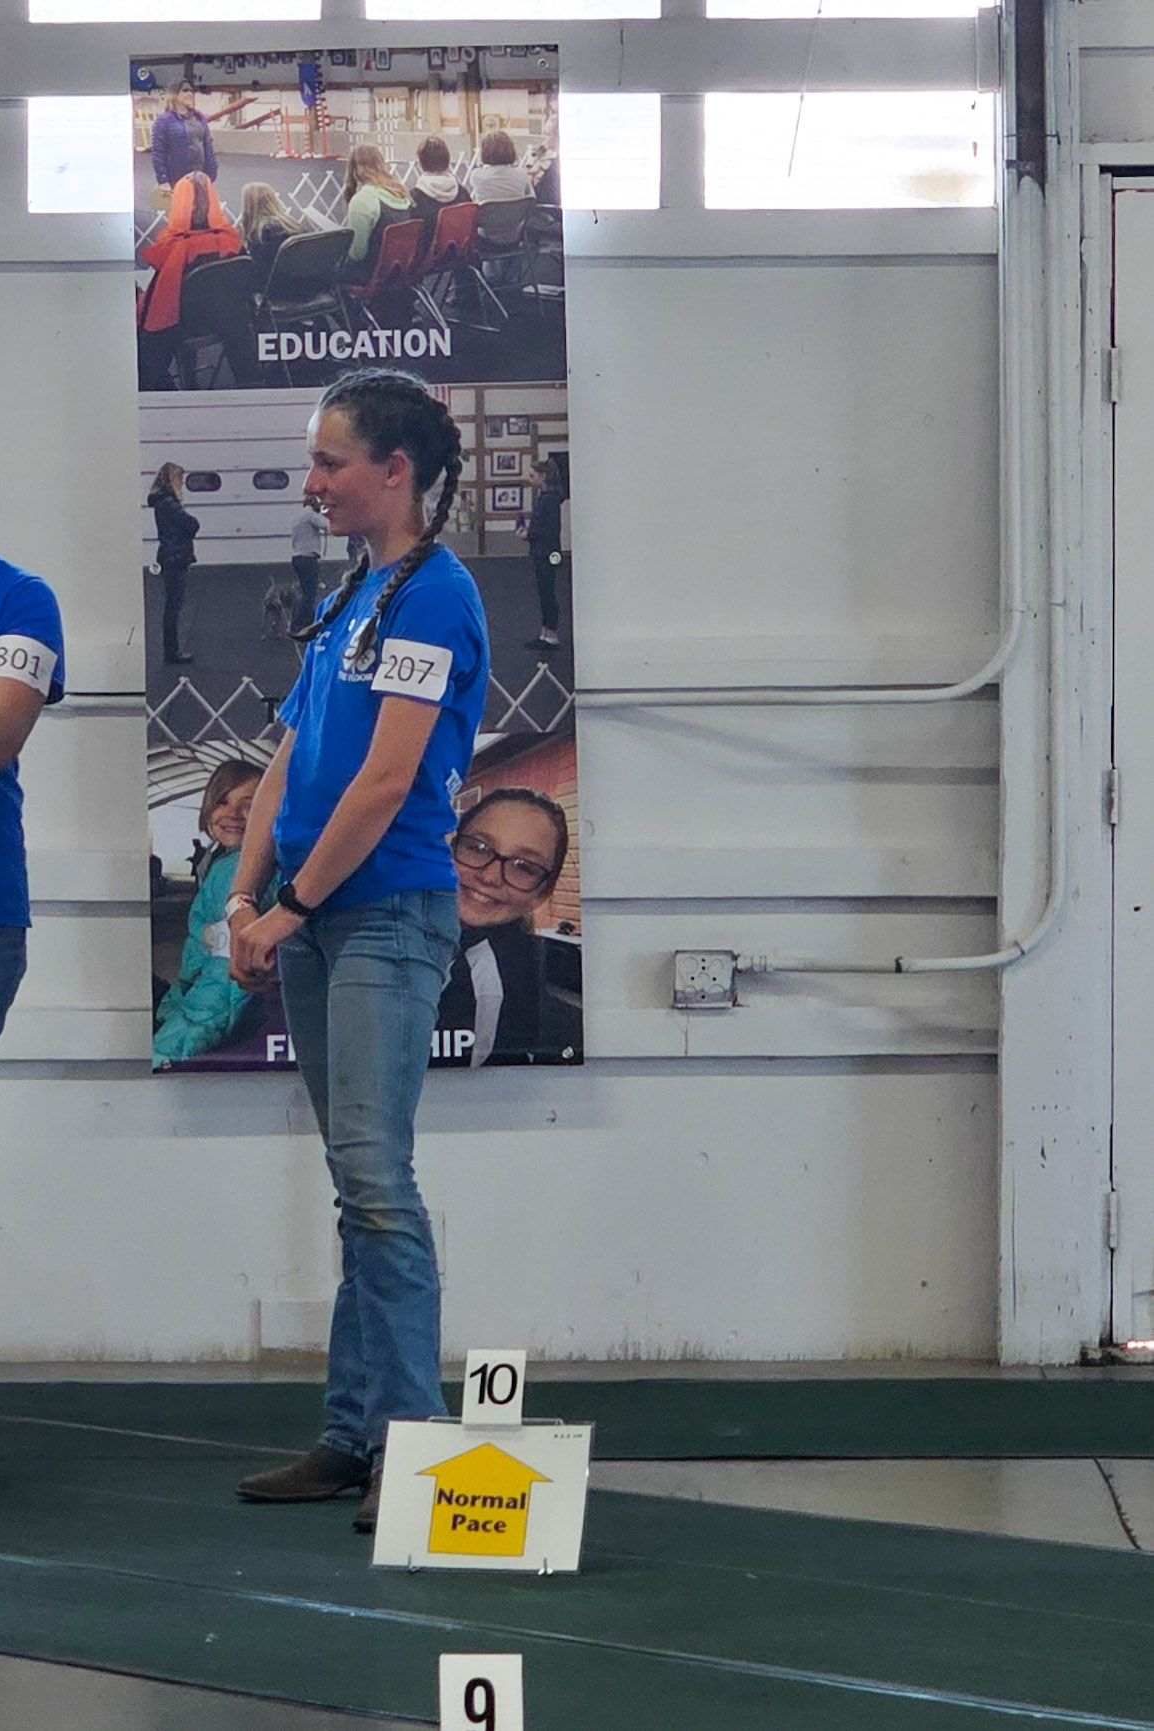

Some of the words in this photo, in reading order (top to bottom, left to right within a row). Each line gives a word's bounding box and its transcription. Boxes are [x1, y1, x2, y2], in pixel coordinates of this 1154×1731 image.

[257, 328, 451, 361] EDUCATION
[384, 655, 435, 684] 207
[469, 1362, 518, 1405] 10
[436, 1488, 527, 1510] Normal
[451, 1513, 507, 1533] Pace
[464, 1677, 496, 1731] 9
